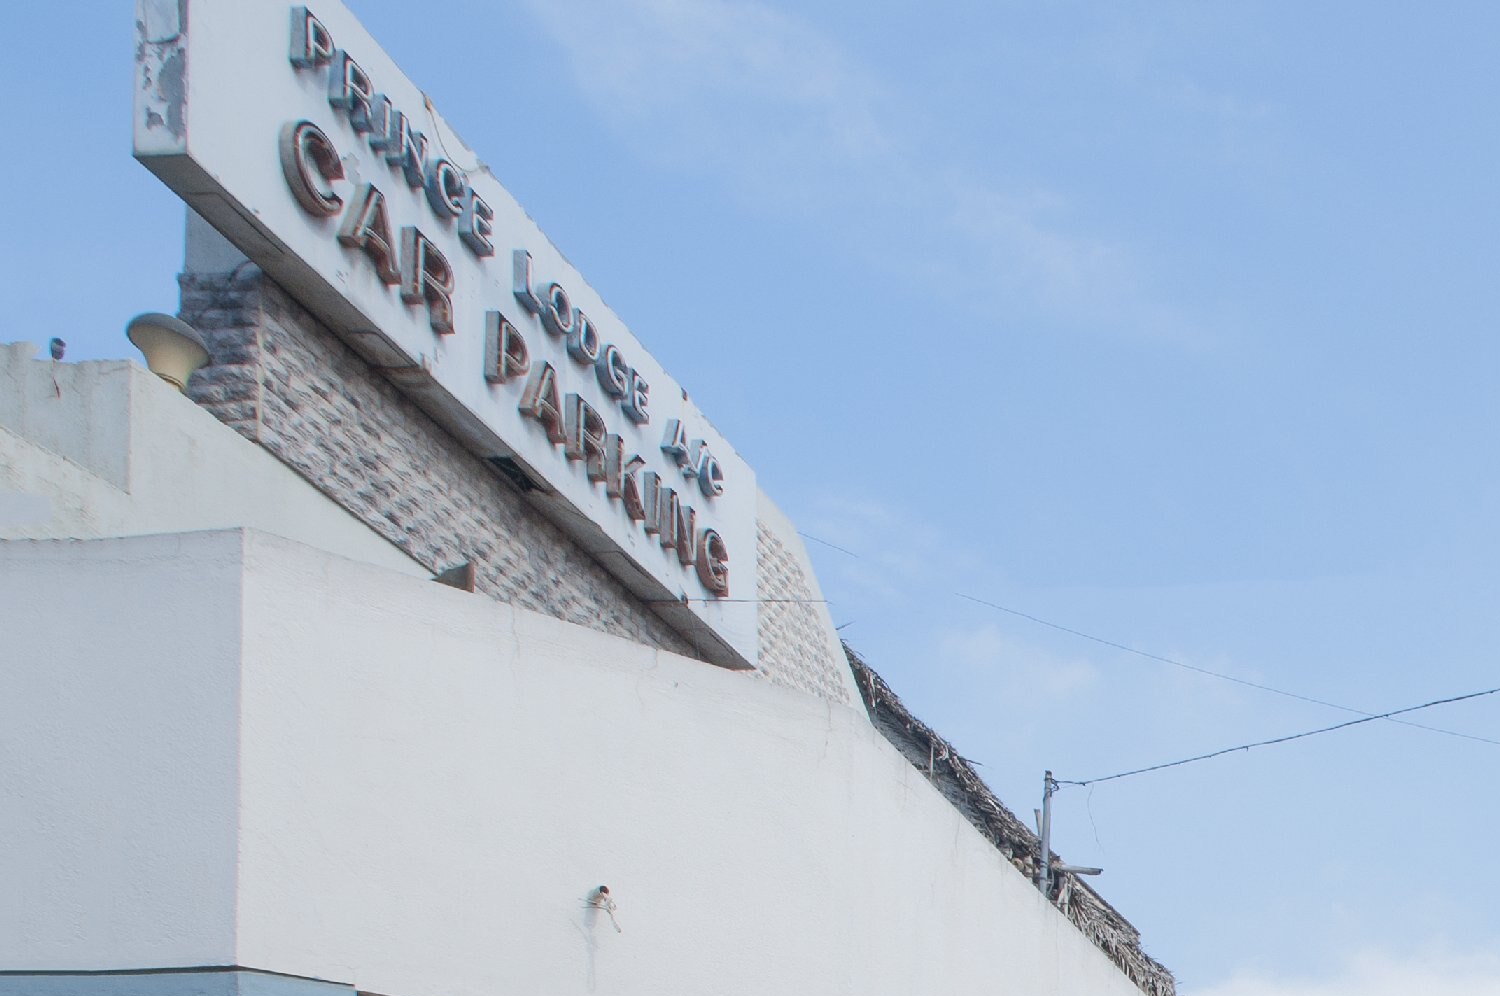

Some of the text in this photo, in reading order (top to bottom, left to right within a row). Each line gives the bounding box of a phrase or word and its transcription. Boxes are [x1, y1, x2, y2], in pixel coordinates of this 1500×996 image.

[279, 119, 729, 597] CAR PARKING
[290, 6, 725, 498] PRINCE LODGE A/C
